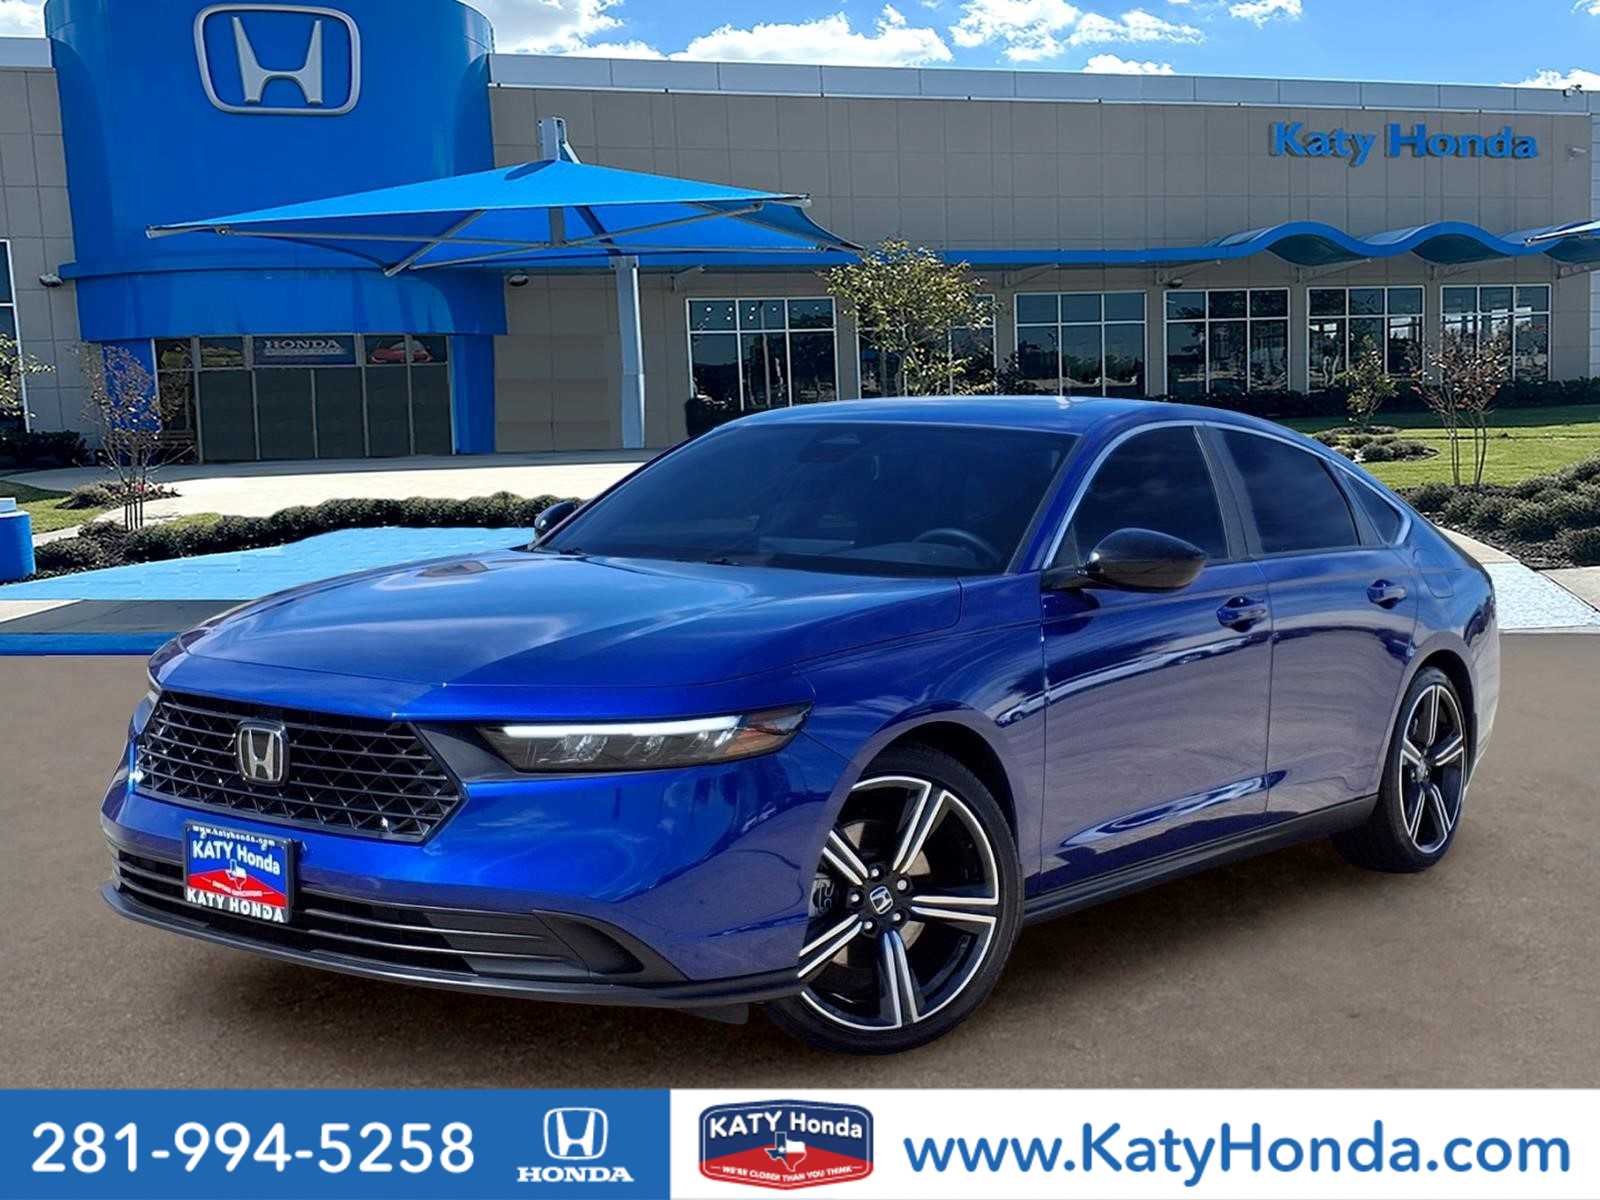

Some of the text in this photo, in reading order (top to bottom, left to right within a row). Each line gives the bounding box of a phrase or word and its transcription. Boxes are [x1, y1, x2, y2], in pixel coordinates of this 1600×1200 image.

[1269, 121, 1539, 167] Katy Honda
[264, 339, 341, 350] HONDA
[192, 839, 281, 876] KATY Honda
[186, 886, 225, 909] KATY
[229, 898, 285, 923] HONDA
